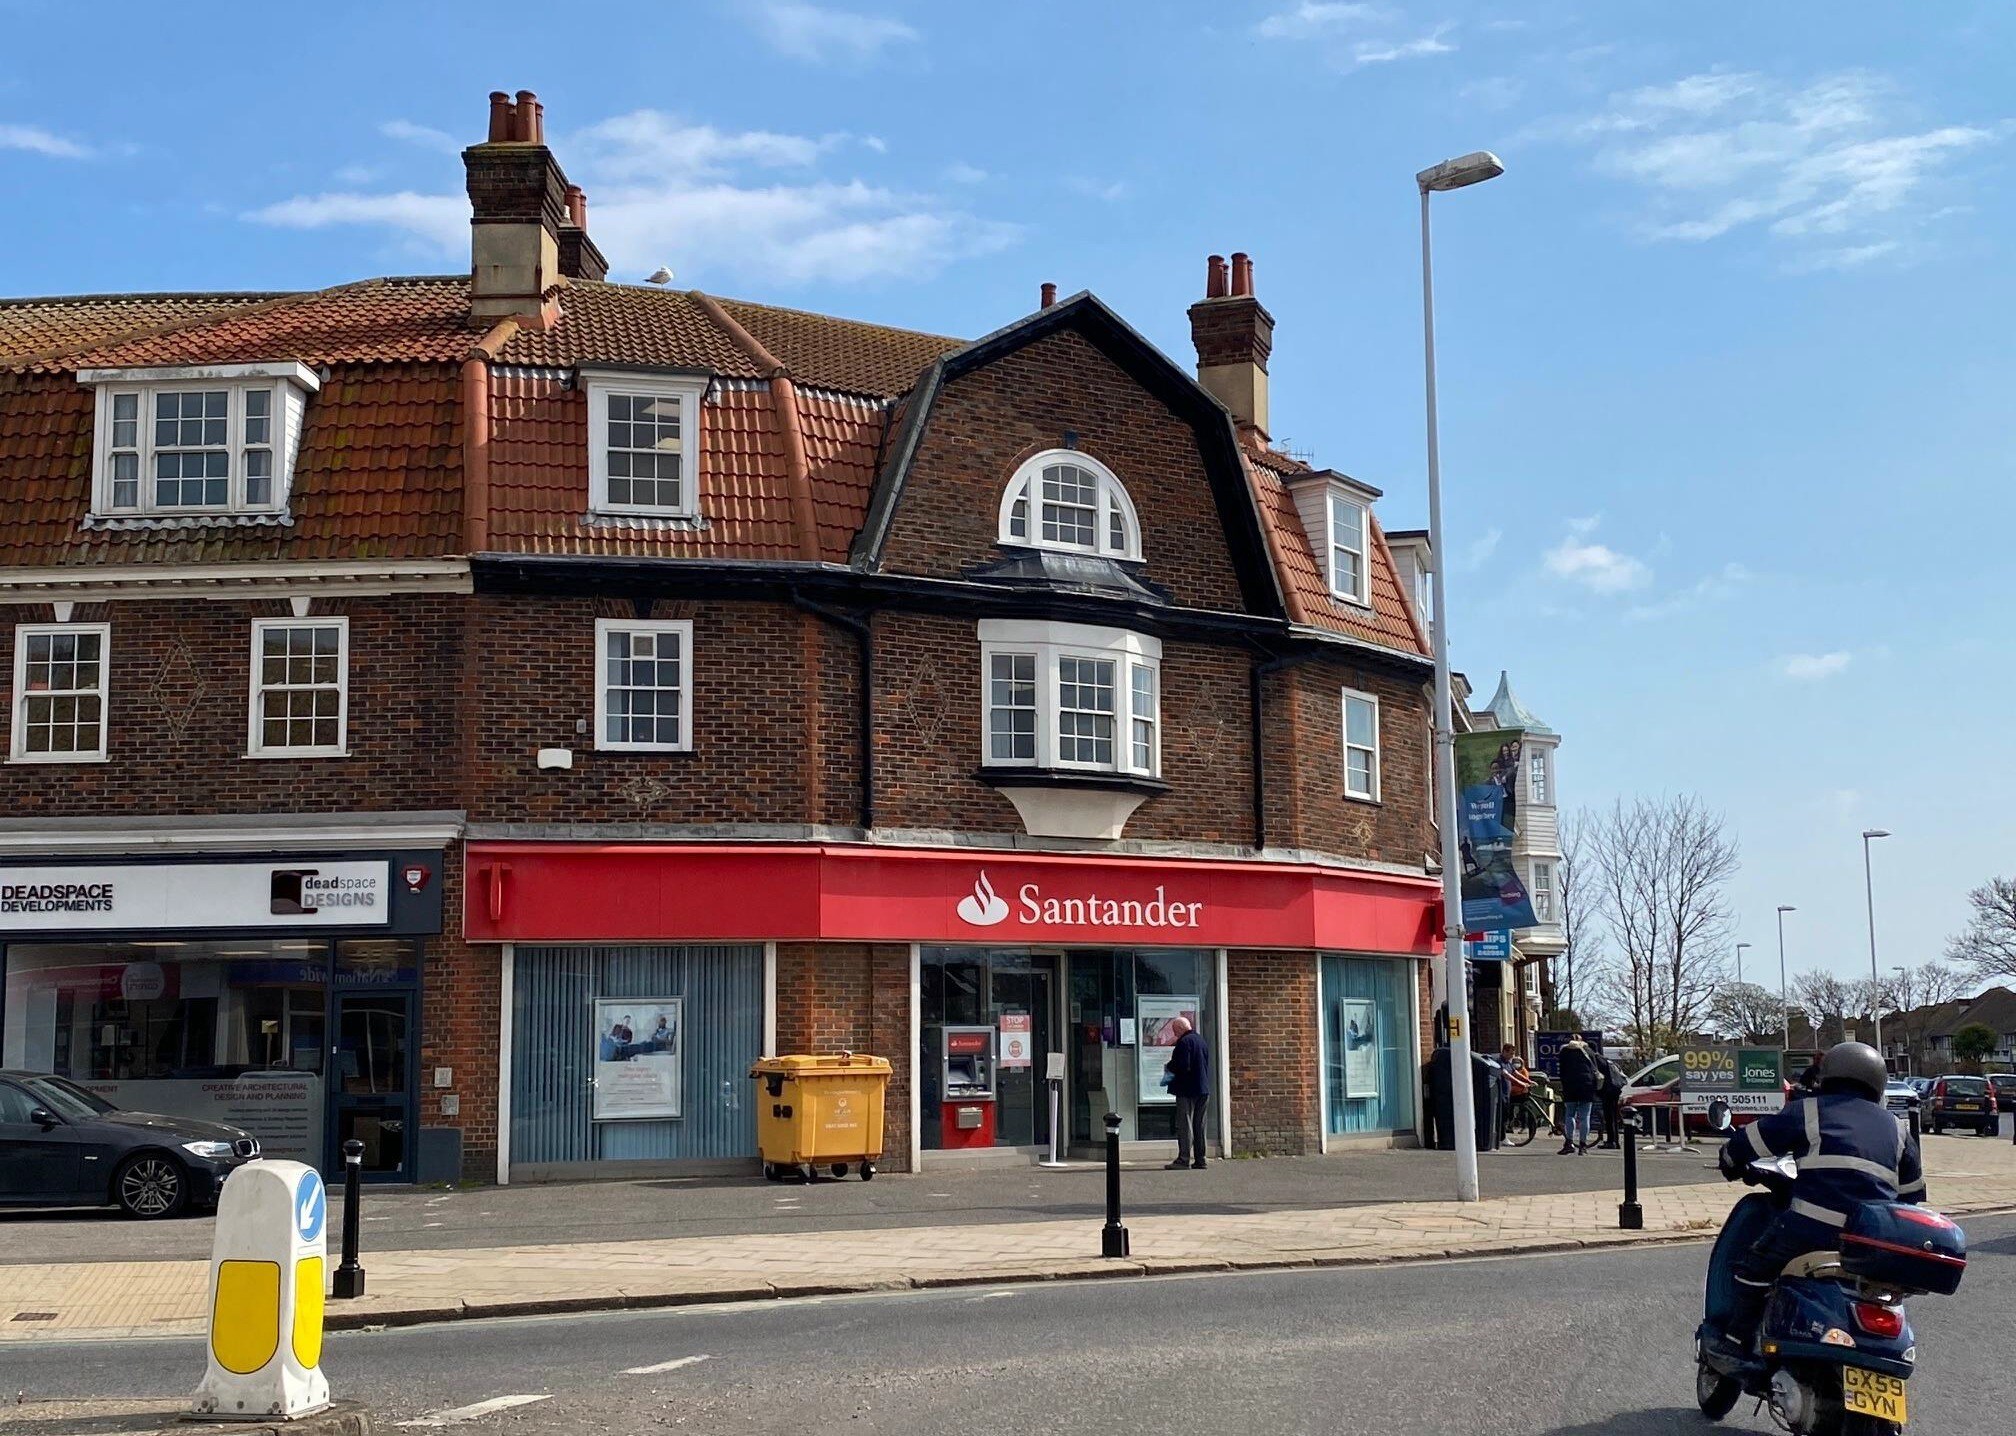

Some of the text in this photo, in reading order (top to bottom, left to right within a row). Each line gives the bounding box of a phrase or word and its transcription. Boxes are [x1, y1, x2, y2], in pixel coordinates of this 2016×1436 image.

[304, 876, 376, 890] deadspace
[1, 883, 114, 900] DEADSPACE
[1, 899, 113, 912] DEVELOPMENTS
[304, 892, 375, 907] DESIGNS
[1018, 883, 1203, 928] Santander
[1006, 1015, 1024, 1024] STOP
[1684, 1050, 1734, 1070] 99%
[1685, 1070, 1734, 1082] say yes
[1742, 1066, 1776, 1078] Jones
[202, 1083, 308, 1092] CREATIVE ARCHITECTURAL
[214, 1092, 306, 1101] DESIGN AND PLANNING
[1731, 1094, 1767, 1104] 505111
[1845, 1367, 1903, 1397] GX59
[1853, 1390, 1897, 1417] GYN
